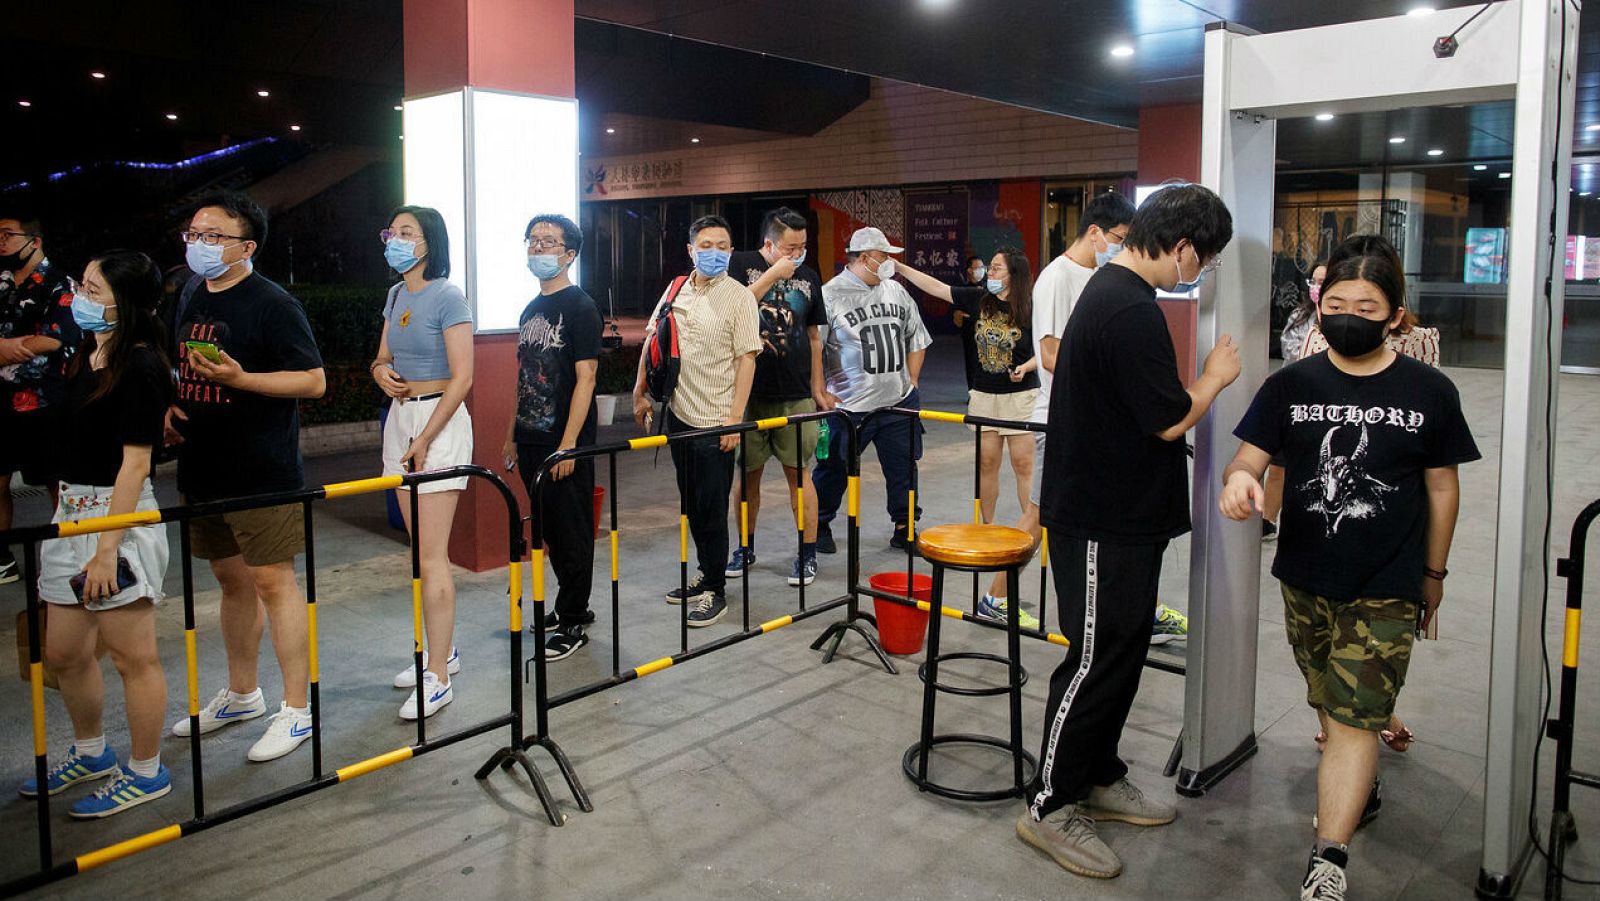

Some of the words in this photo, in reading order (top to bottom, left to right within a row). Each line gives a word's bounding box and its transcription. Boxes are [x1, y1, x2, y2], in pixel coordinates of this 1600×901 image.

[844, 303, 906, 328] BD.CLUB
[190, 323, 218, 342] EAT.
[1289, 403, 1425, 435] BATHORY
